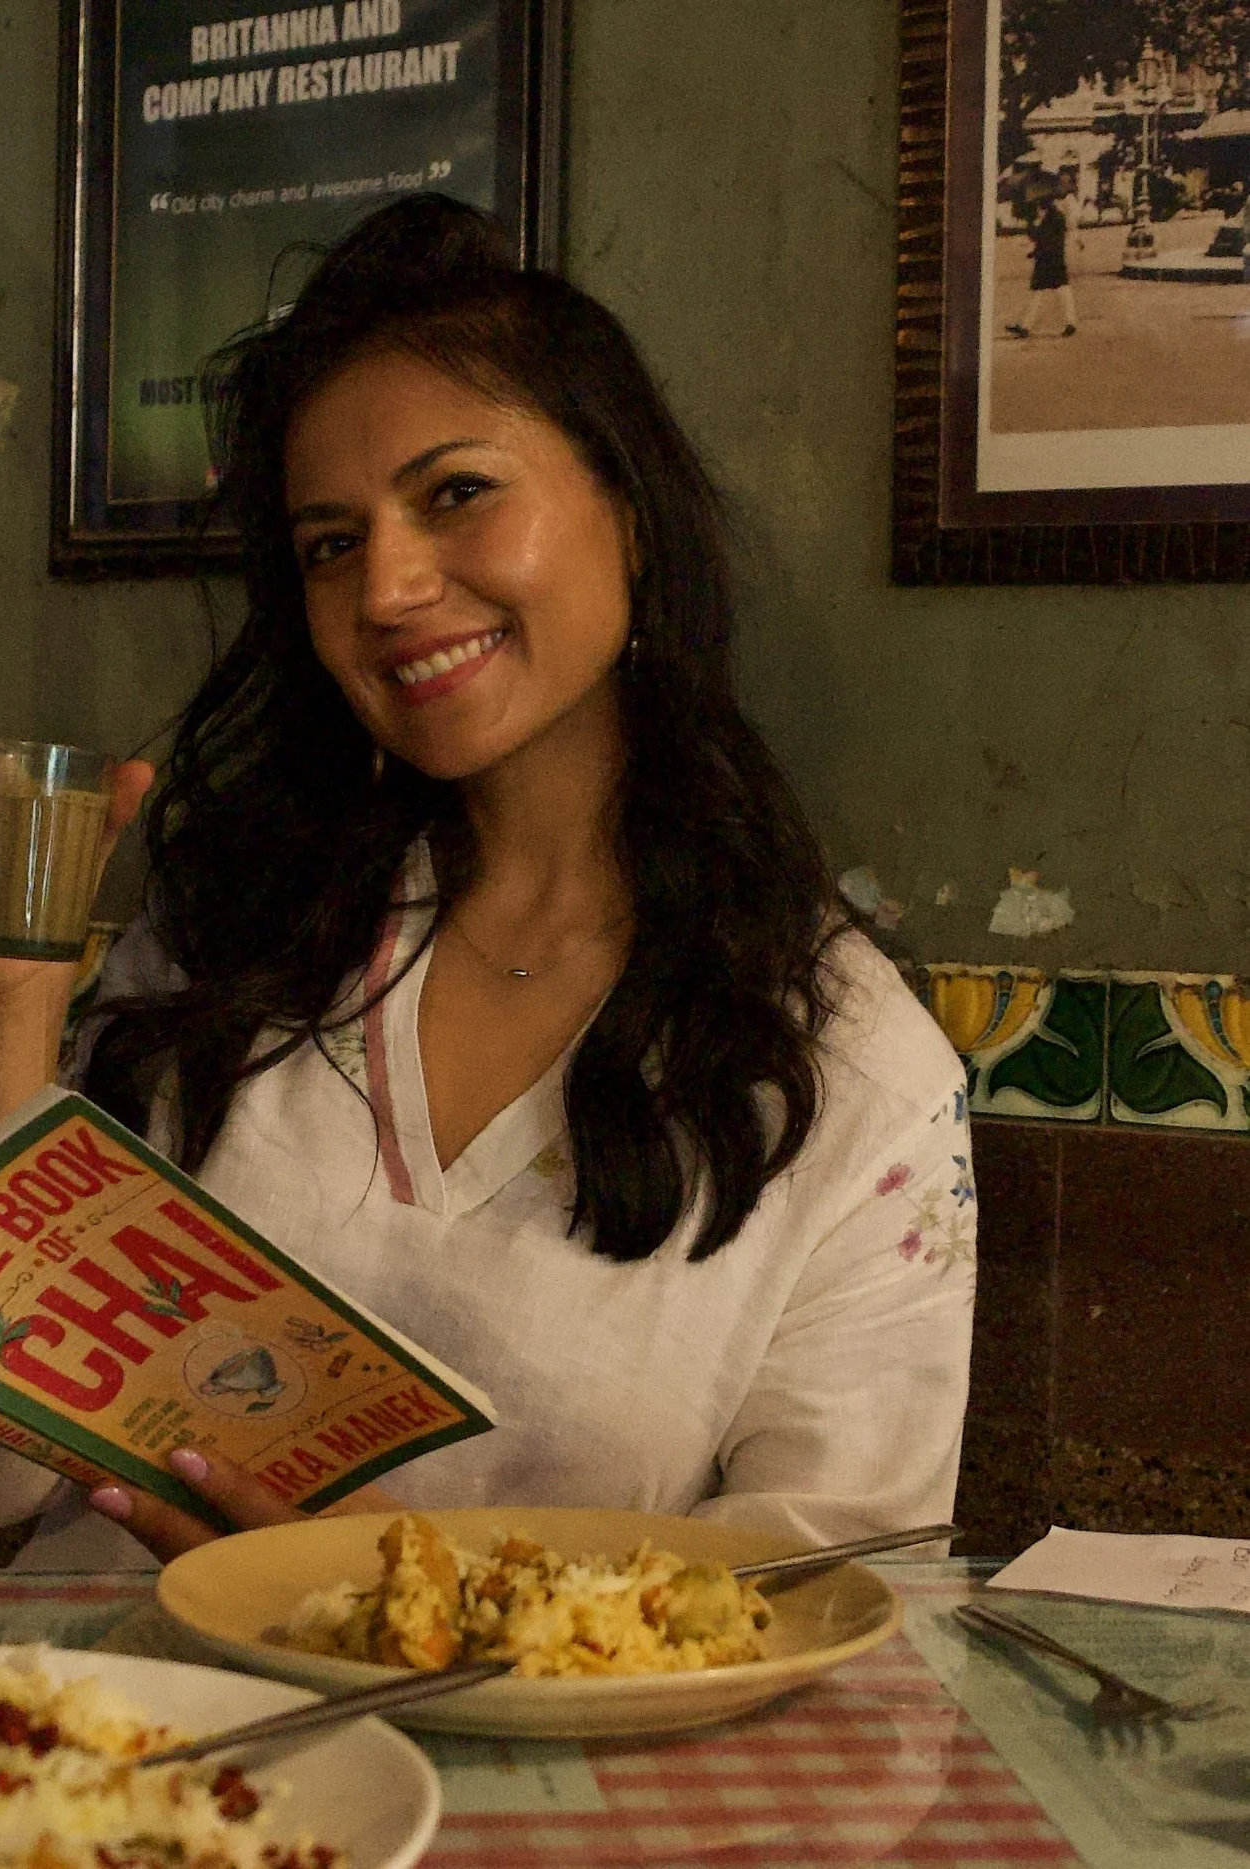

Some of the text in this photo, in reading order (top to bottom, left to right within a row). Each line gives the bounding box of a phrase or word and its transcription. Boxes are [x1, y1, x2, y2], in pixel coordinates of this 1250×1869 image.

[191, 0, 401, 64] BRITANNIA AND
[142, 40, 462, 123] COMPANY RESTAURANT
[280, 184, 307, 202] and
[35, 1226, 78, 1263] OF
[1, 1198, 285, 1412] CHAI
[254, 1384, 452, 1500] IRA MANEK
